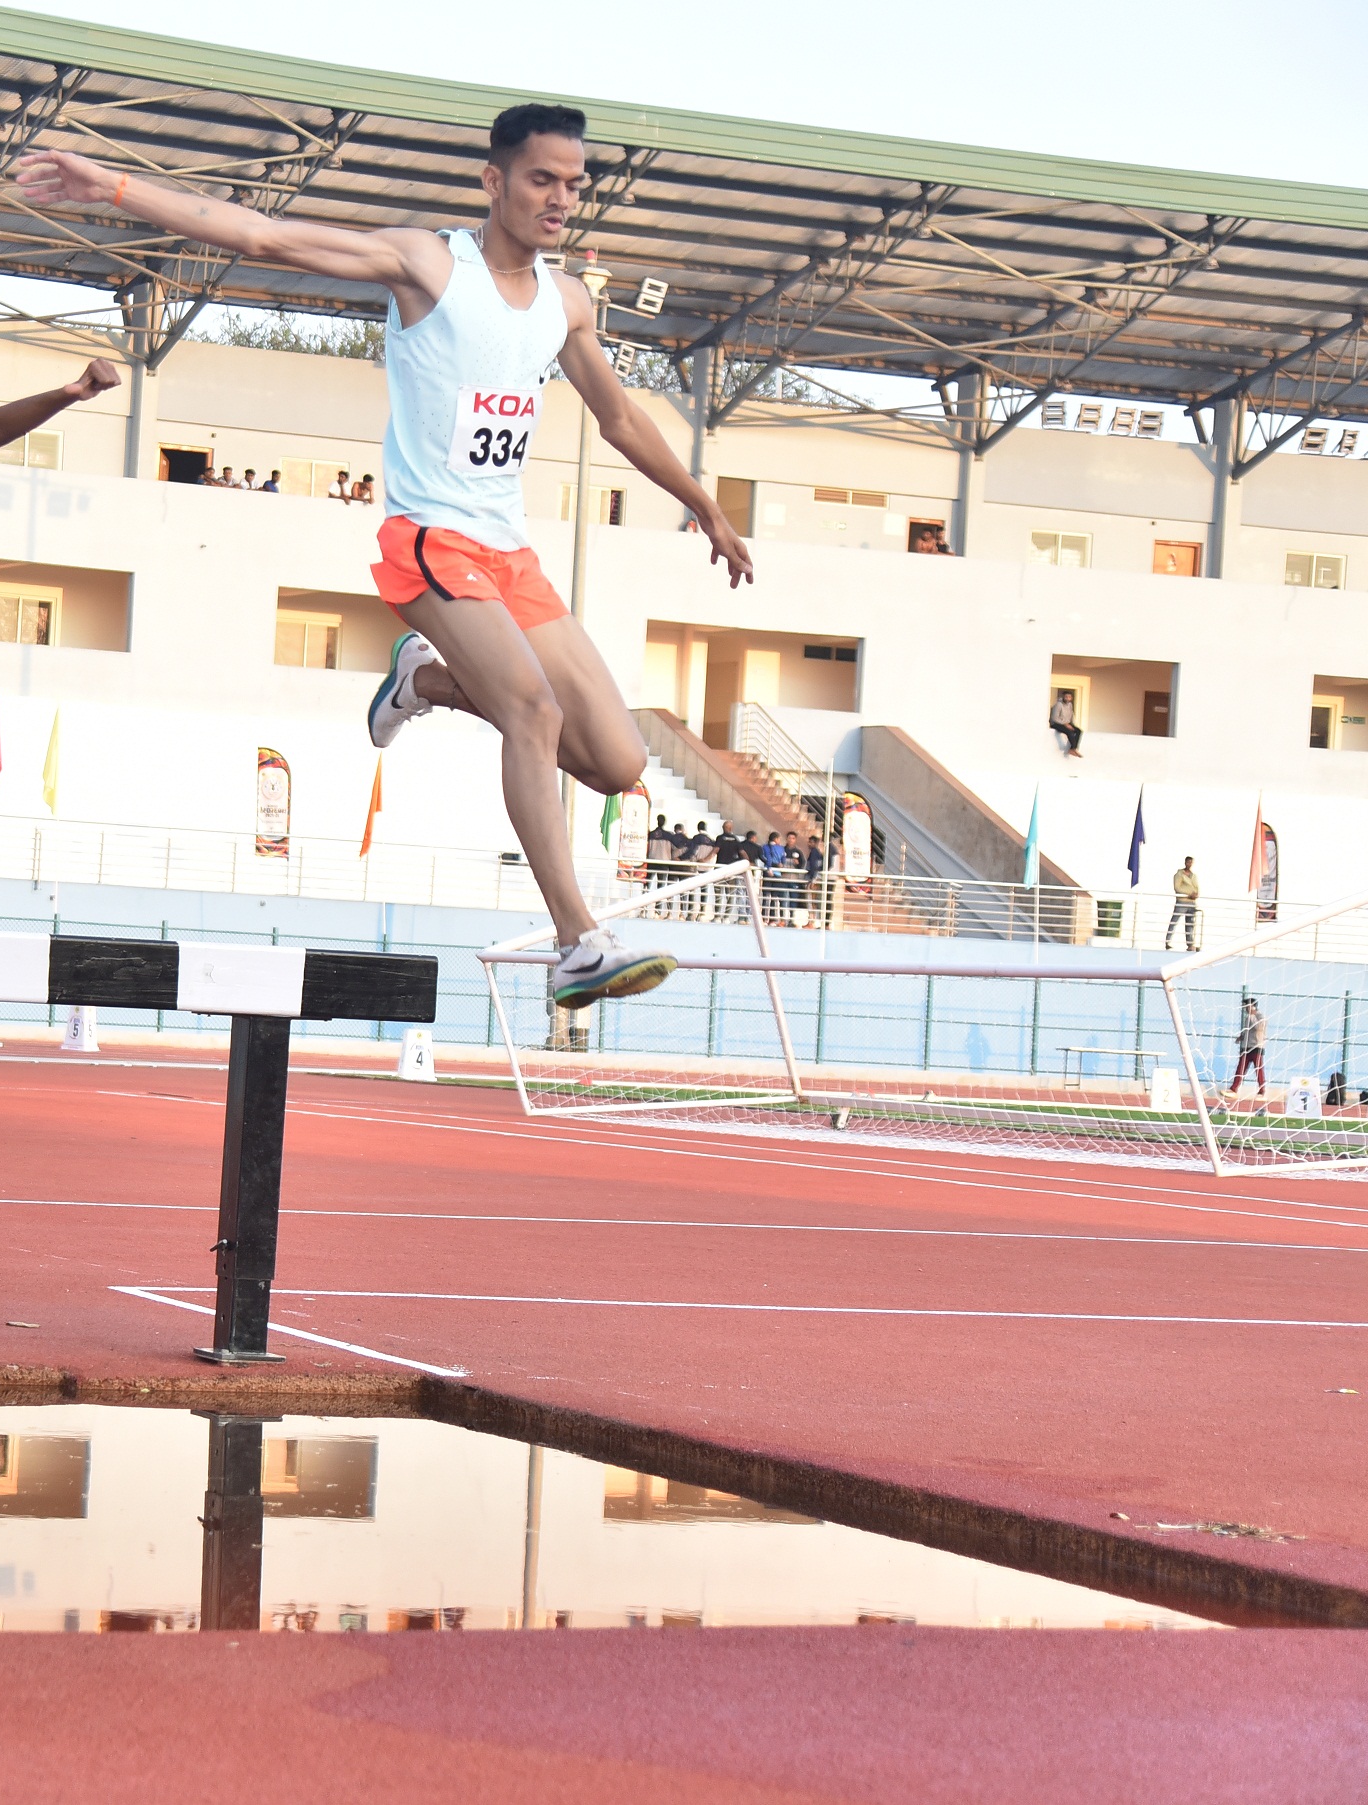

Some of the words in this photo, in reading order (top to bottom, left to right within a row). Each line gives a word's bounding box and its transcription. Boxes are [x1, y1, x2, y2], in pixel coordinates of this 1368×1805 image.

[473, 392, 535, 417] KOA
[469, 427, 528, 467] 334
[73, 1023, 79, 1037] 5
[416, 1051, 423, 1066] 4
